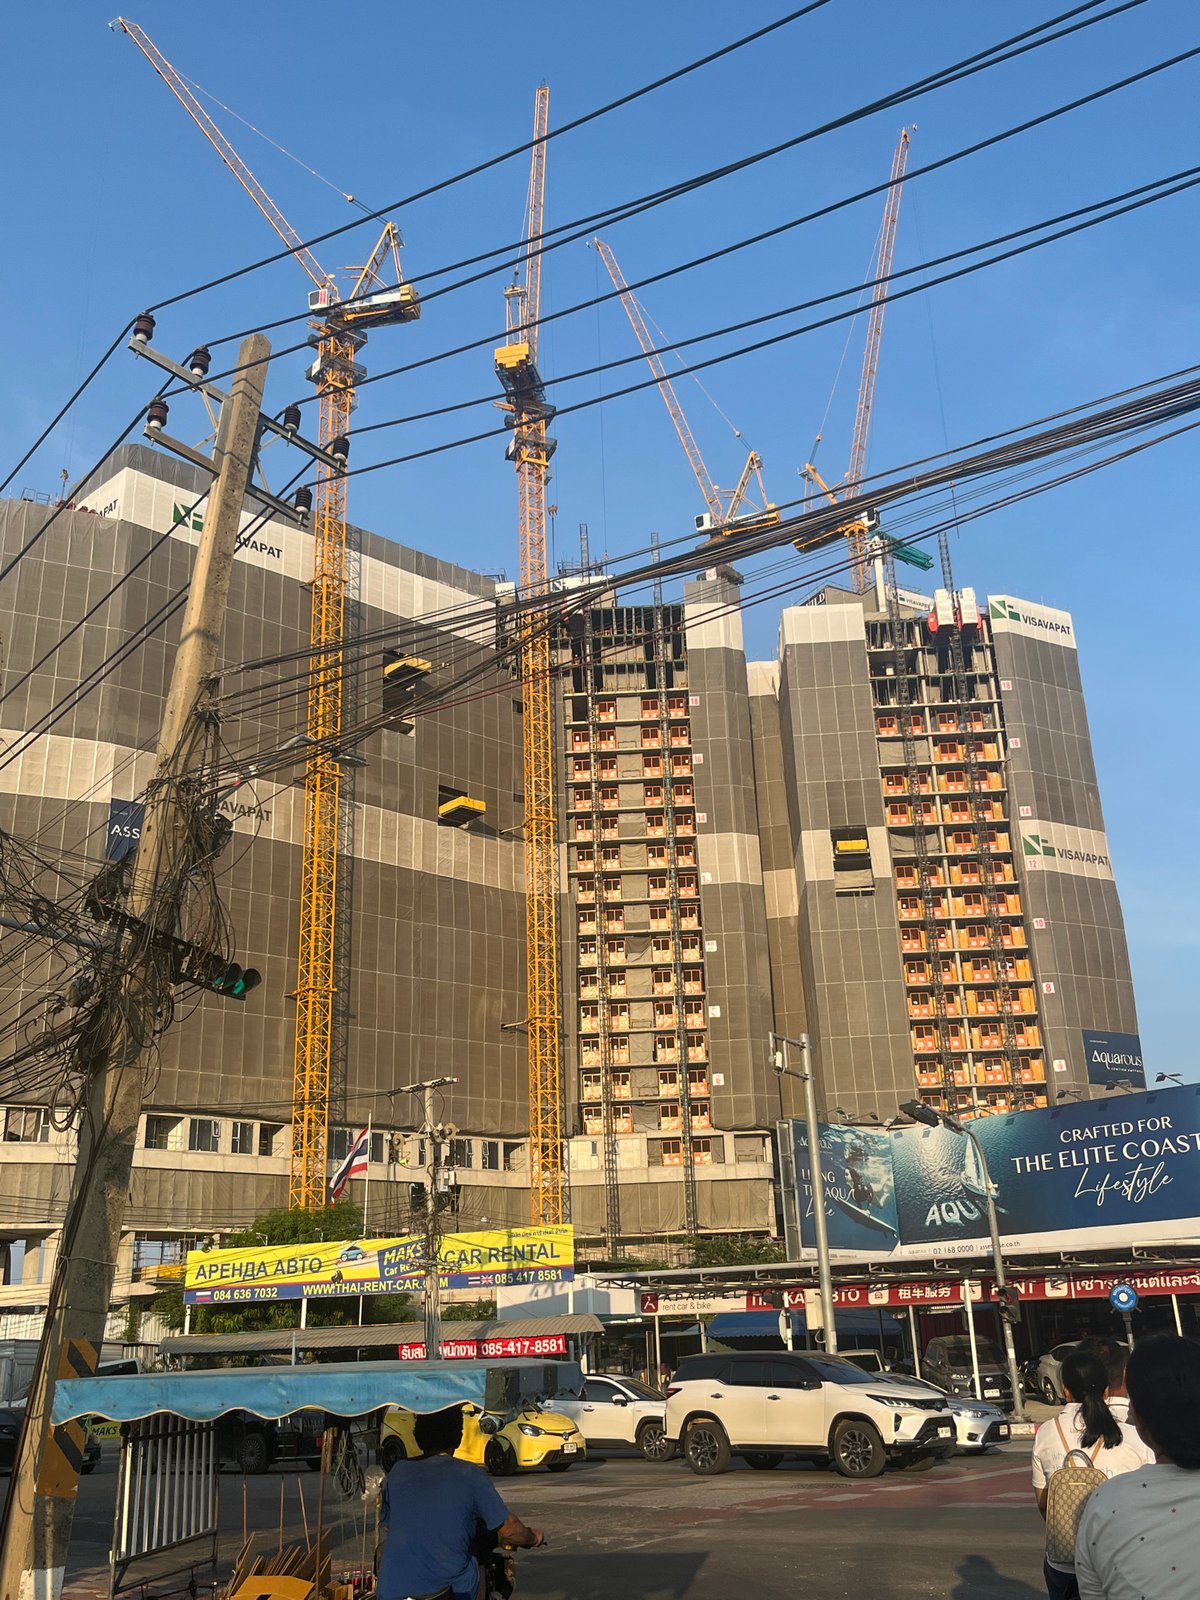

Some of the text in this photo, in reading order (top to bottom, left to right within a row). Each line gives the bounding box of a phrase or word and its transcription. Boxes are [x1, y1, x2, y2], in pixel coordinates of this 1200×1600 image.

[1021, 614, 1071, 635] VISAVAPAT
[1029, 860, 1038, 868] 12
[1057, 848, 1109, 867] VISAVAPAT
[1035, 919, 1044, 928] 10
[1045, 983, 1052, 992] 8
[1092, 1049, 1143, 1070] Aquarous
[1060, 1116, 1173, 1143] CRAFTED FOR
[1011, 1153, 1054, 1174] THE
[1058, 1144, 1119, 1168] ELITE
[1074, 1161, 1174, 1206] Lifestyle
[383, 1242, 426, 1266] MAKS
[443, 1242, 561, 1266] CAR RENTAL
[944, 1246, 956, 1254] 168
[958, 1244, 974, 1253] 0000
[195, 1257, 322, 1281] АРЕНДА АВТО
[384, 1266, 398, 1277] Car
[495, 1269, 562, 1284] 085 417 8581
[213, 1287, 278, 1301] 084 636 7032
[663, 1303, 676, 1311] rent
[696, 1301, 711, 1310] bike
[482, 1338, 564, 1356] 085-417-8581
[93, 1426, 118, 1437] MAKS
